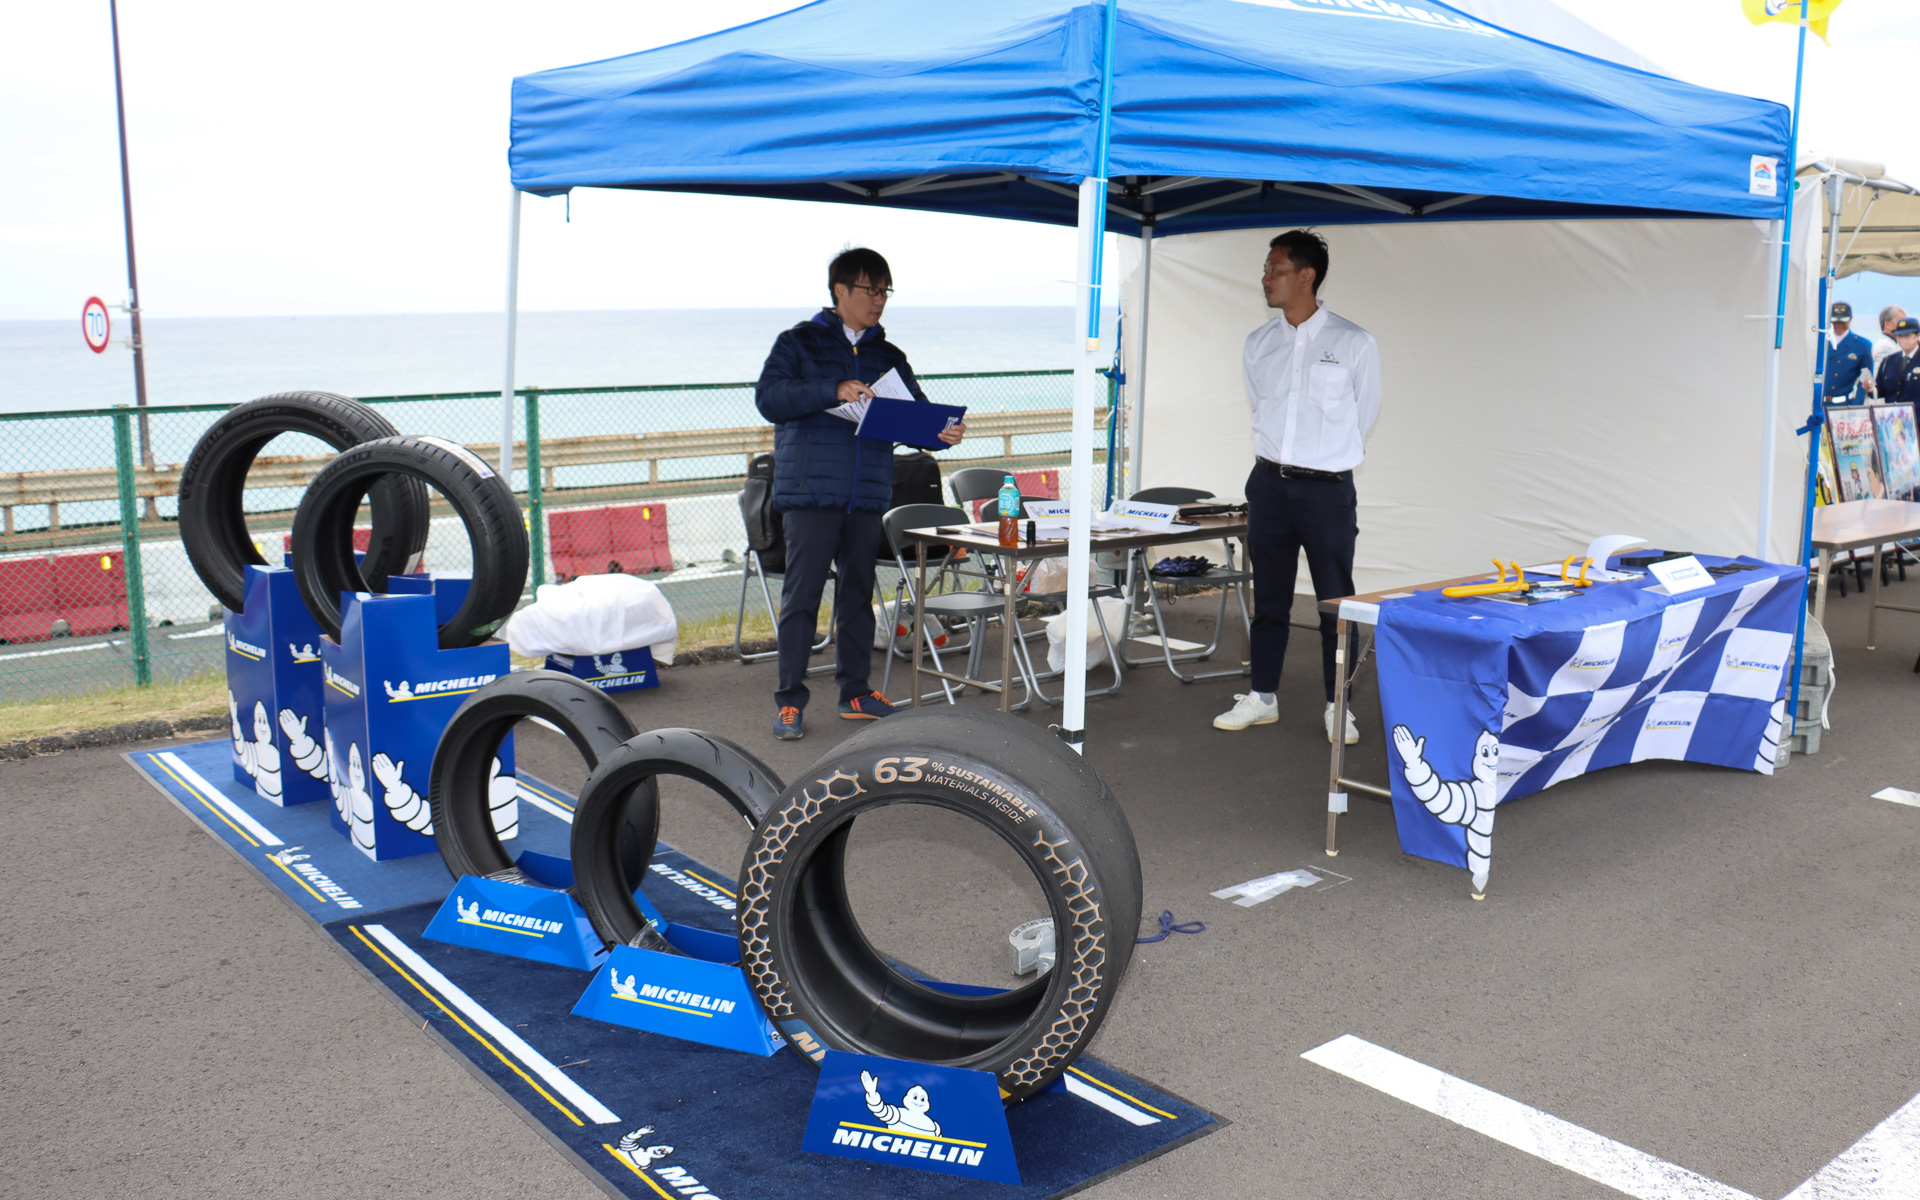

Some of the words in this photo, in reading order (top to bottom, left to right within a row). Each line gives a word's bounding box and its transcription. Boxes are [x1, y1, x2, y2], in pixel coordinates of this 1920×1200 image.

[1306, 0, 1511, 38] CHELIN
[87, 313, 104, 337] 70
[187, 427, 225, 480] MICHELIN
[1127, 509, 1169, 519] MICHELIN
[1740, 661, 1781, 671] MICHELIN
[414, 674, 496, 694] MICHELIN
[872, 757, 929, 784] 63
[946, 765, 1038, 819] SUSTAINABLE
[925, 774, 989, 801] MATERIALS
[988, 797, 1026, 825] INSIDE
[292, 863, 363, 909] MICHELIN
[482, 909, 563, 934] MICHELIN
[640, 983, 736, 1014] MICHELIN
[832, 1128, 984, 1166] MICHELIN
